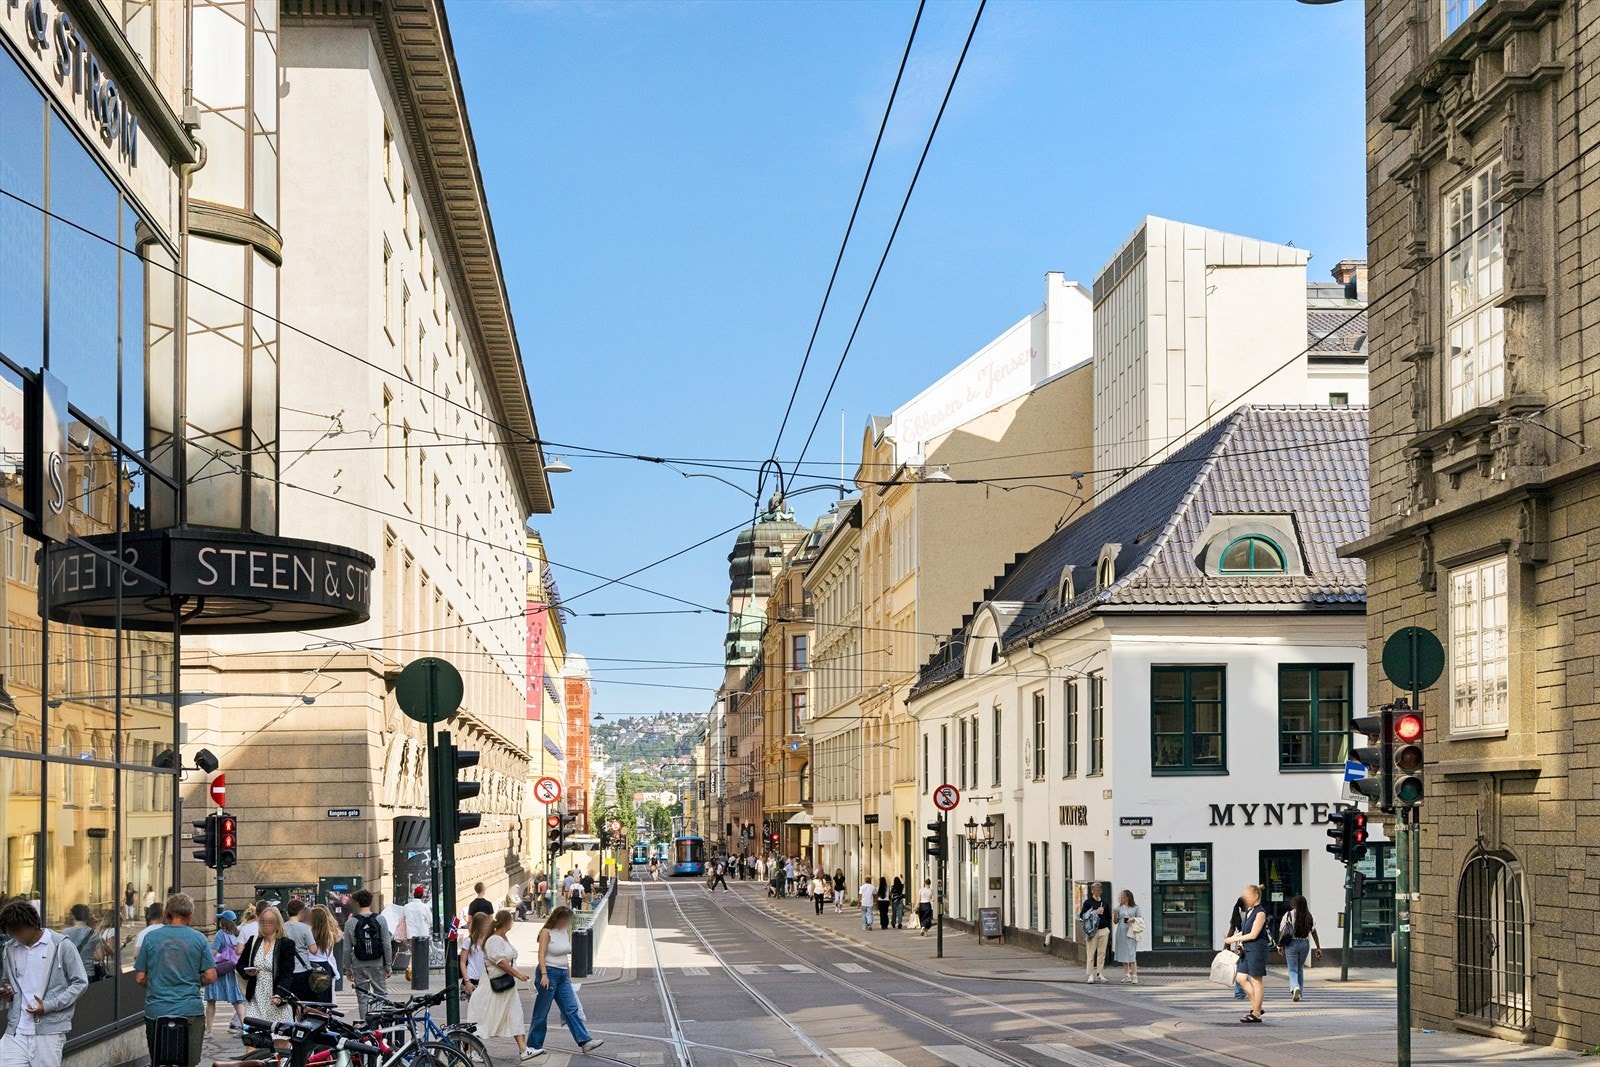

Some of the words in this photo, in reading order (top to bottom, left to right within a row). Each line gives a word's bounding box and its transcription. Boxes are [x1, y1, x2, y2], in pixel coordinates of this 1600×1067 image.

[55, 11, 138, 169] STRØM
[902, 399, 964, 443] Ebbesen
[965, 386, 981, 402] &
[977, 347, 1037, 399] Jensen
[49, 451, 64, 515] S
[197, 547, 316, 593] STEEN
[324, 559, 341, 598] &
[1059, 805, 1088, 826] MYNTER
